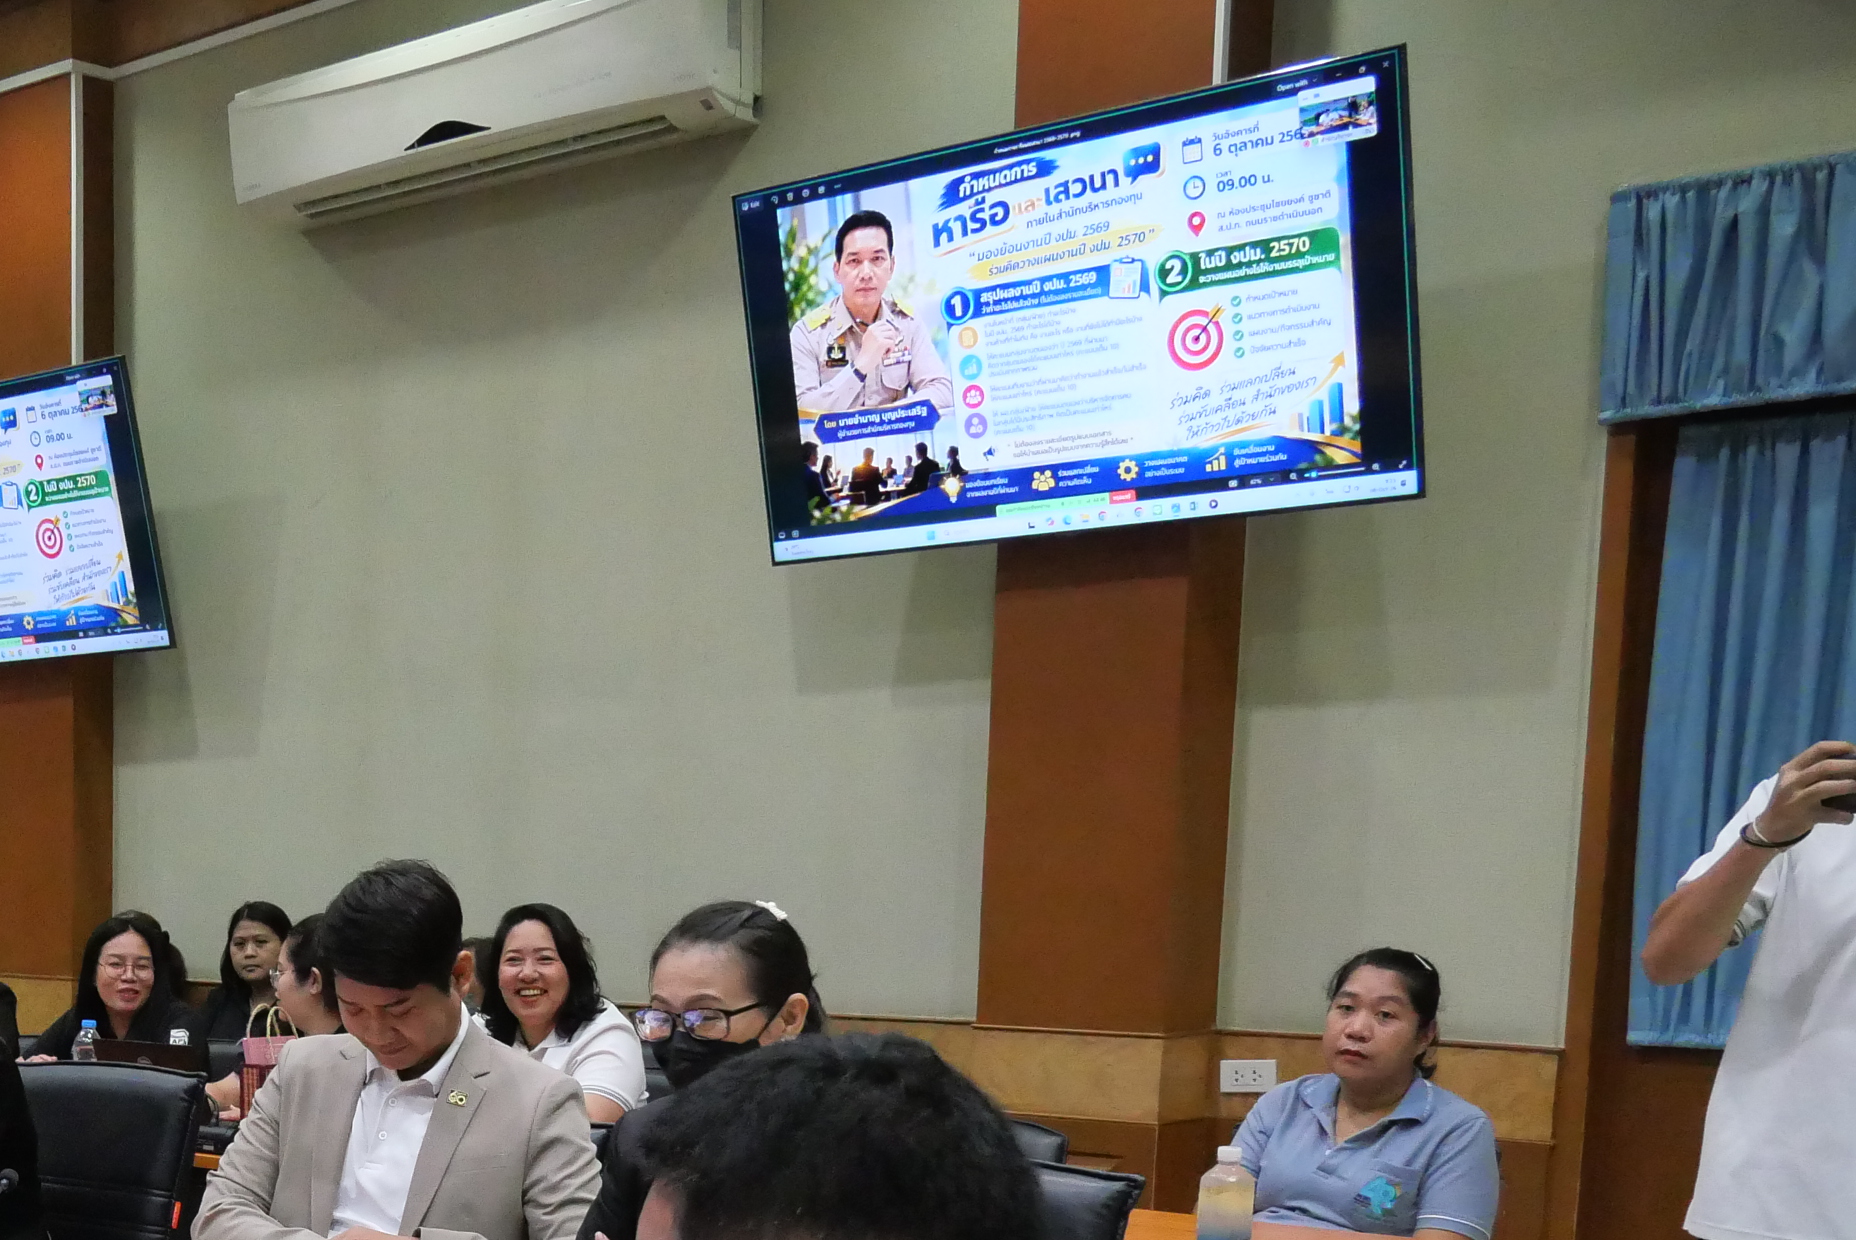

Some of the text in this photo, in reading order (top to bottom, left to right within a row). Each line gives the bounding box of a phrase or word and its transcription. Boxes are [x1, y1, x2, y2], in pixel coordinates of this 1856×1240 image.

[1276, 81, 1294, 93] Open
[1211, 120, 1259, 142] วันอังคารที่
[1212, 126, 1303, 159] 6 ตุลาคม 256
[957, 160, 1037, 199] กำหนดการ
[1216, 171, 1274, 193] 09.00 น.
[1025, 190, 1143, 229] ภายในสำนักบริหารกองทุน
[1054, 228, 1078, 243] งปม.
[1081, 219, 1110, 237] 2569
[1089, 238, 1113, 254] งปม.
[1198, 235, 1310, 270] ในปี งปม. 2570
[1164, 257, 1183, 284] 2
[979, 270, 1096, 305] สรุปผลงานปี งปม. 2569
[950, 294, 962, 318] 1
[1169, 364, 1296, 410] ร่วมคิด ร่วมแลกเปลี่ยน
[1177, 375, 1317, 426] ร่วมขับเคลื่อน สำนักของเรา
[40, 410, 46, 420] 6
[1185, 402, 1277, 441] ให้ก้าวไปด้วยกัน
[45, 431, 65, 443] 09.00
[27, 483, 38, 501] 2
[76, 474, 96, 487] 2570
